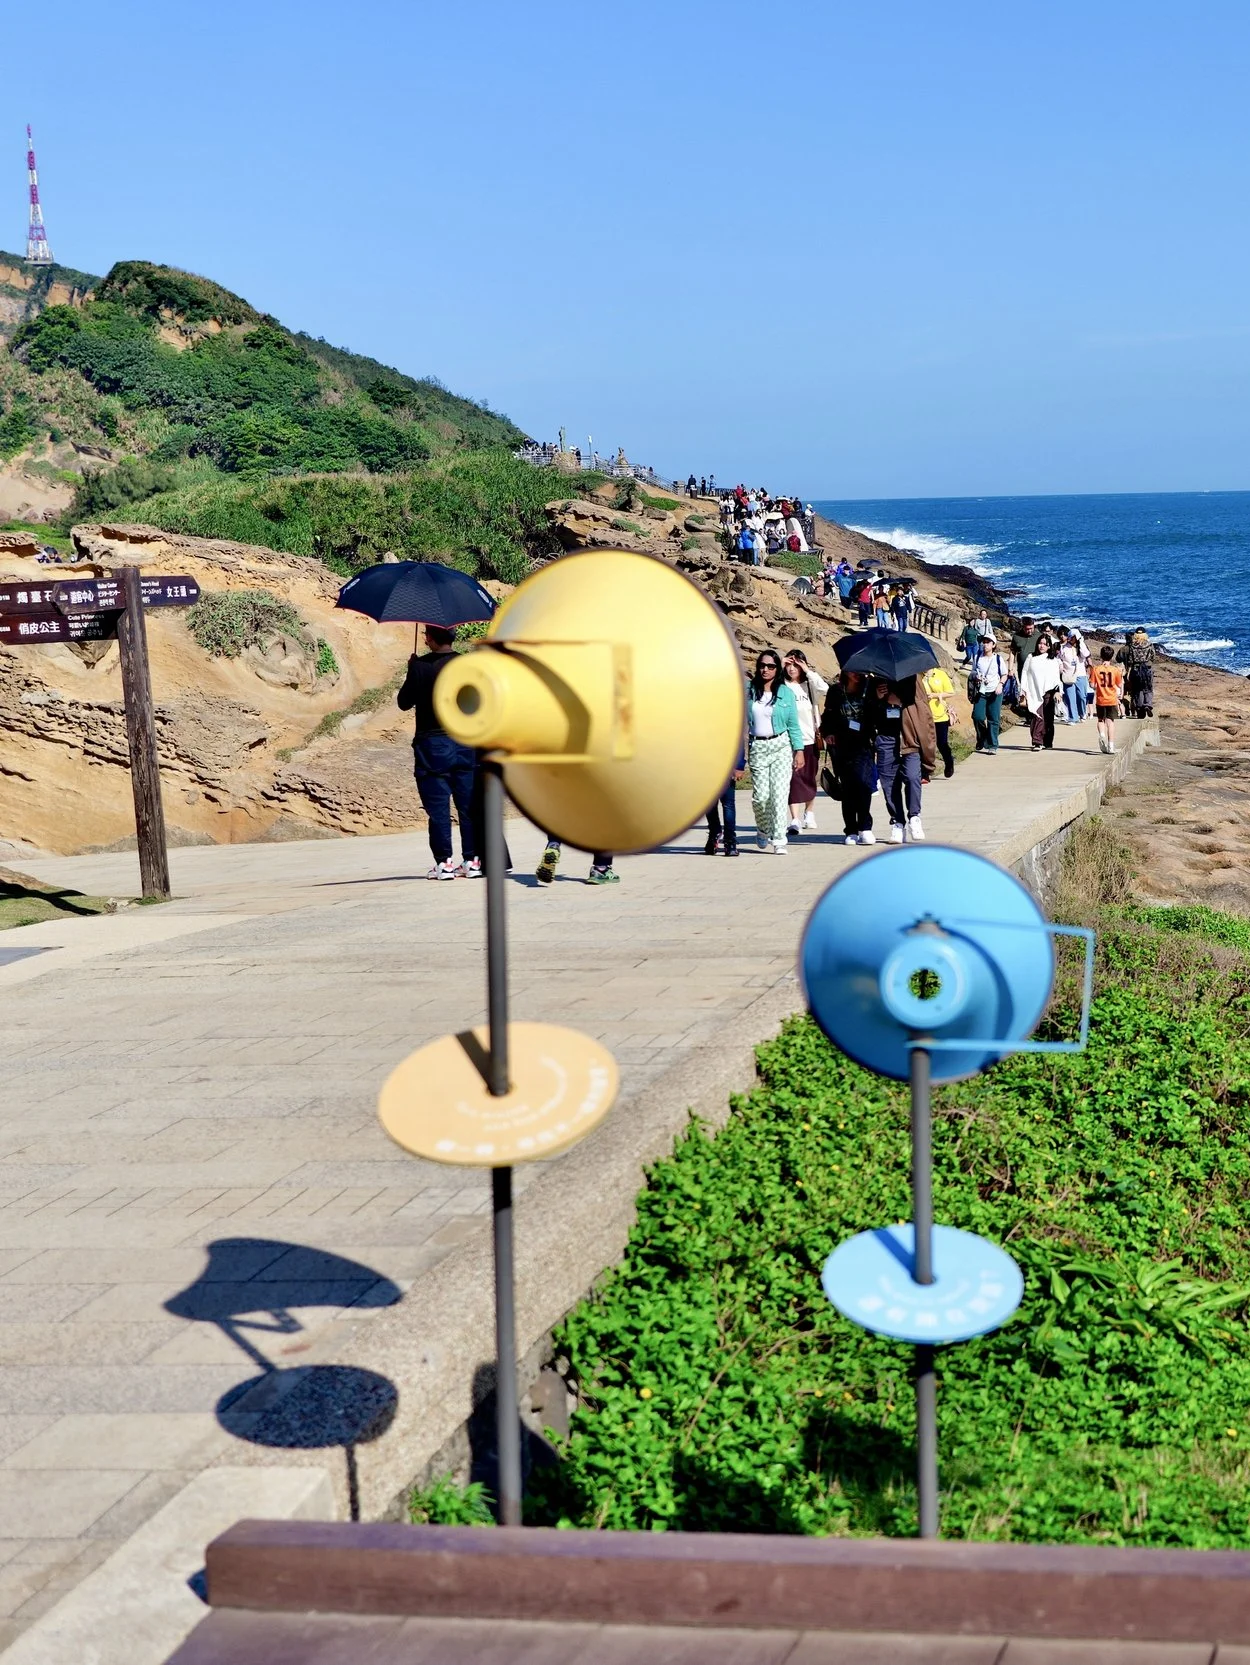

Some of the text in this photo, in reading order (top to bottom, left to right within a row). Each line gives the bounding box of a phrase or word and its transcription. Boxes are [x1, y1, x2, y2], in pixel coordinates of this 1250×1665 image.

[166, 585, 187, 598] 女王頭
[19, 620, 61, 636] 俏皮公主
[1100, 671, 1114, 688] 31
